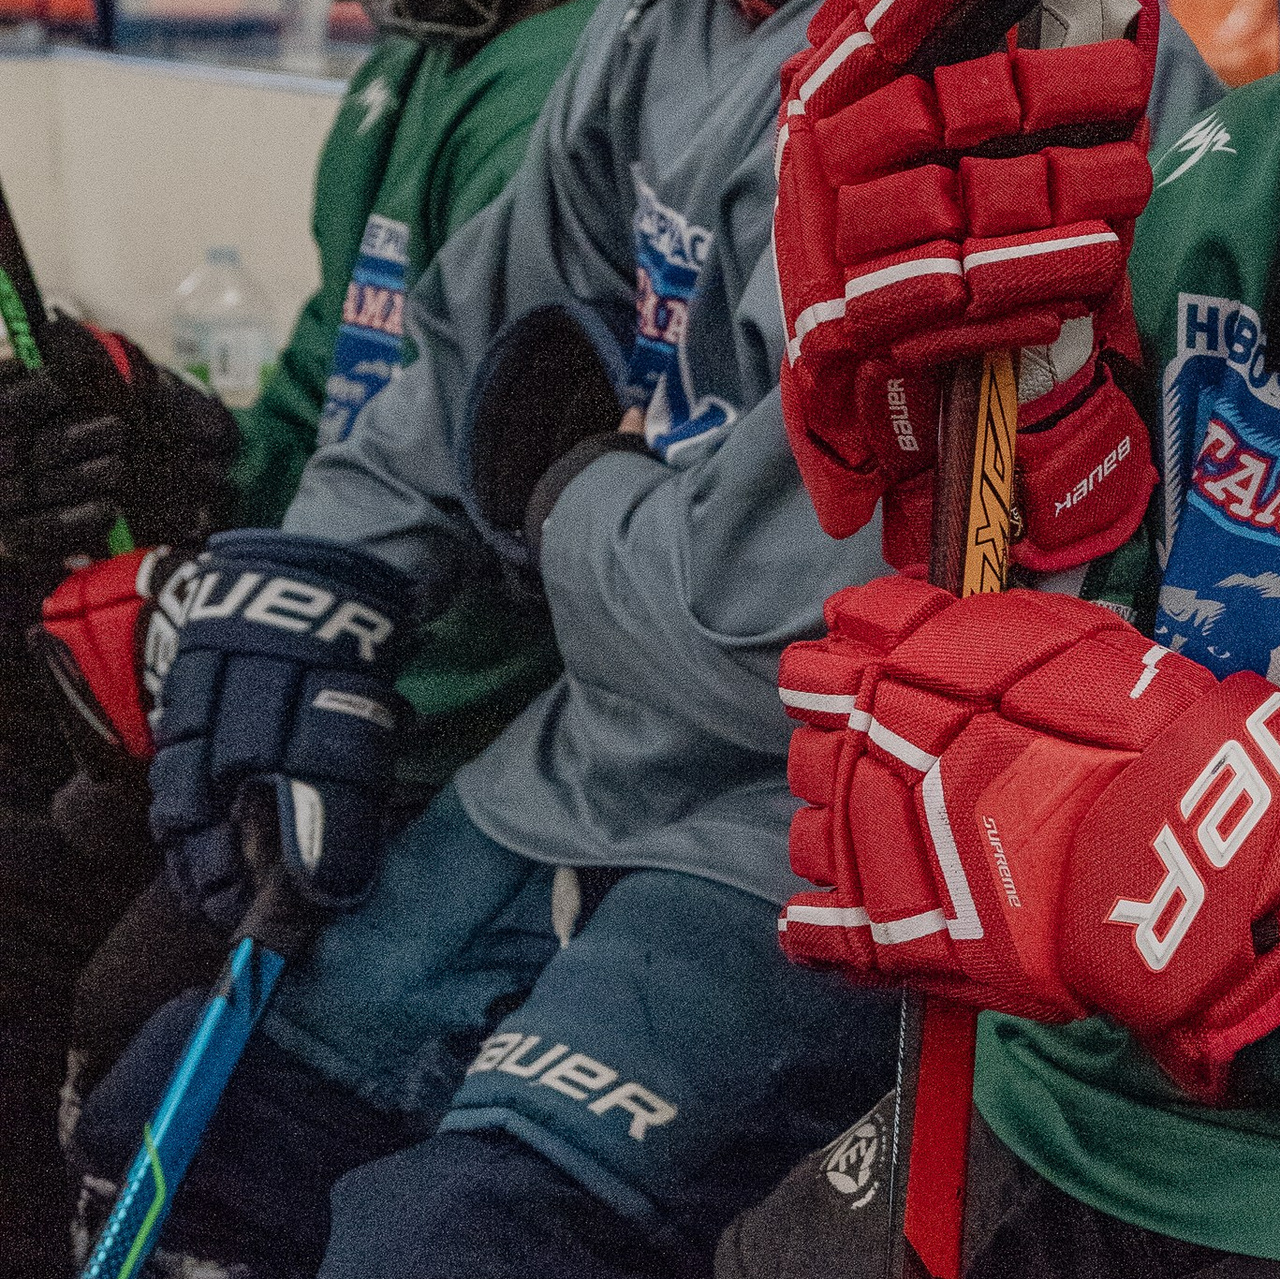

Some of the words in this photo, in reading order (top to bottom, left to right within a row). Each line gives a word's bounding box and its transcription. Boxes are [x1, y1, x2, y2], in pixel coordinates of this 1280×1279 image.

[887, 377, 921, 453] BAUER
[1054, 435, 1131, 518] BAUER
[982, 815, 1022, 908] SUPREME
[469, 1030, 678, 1141] AUER
